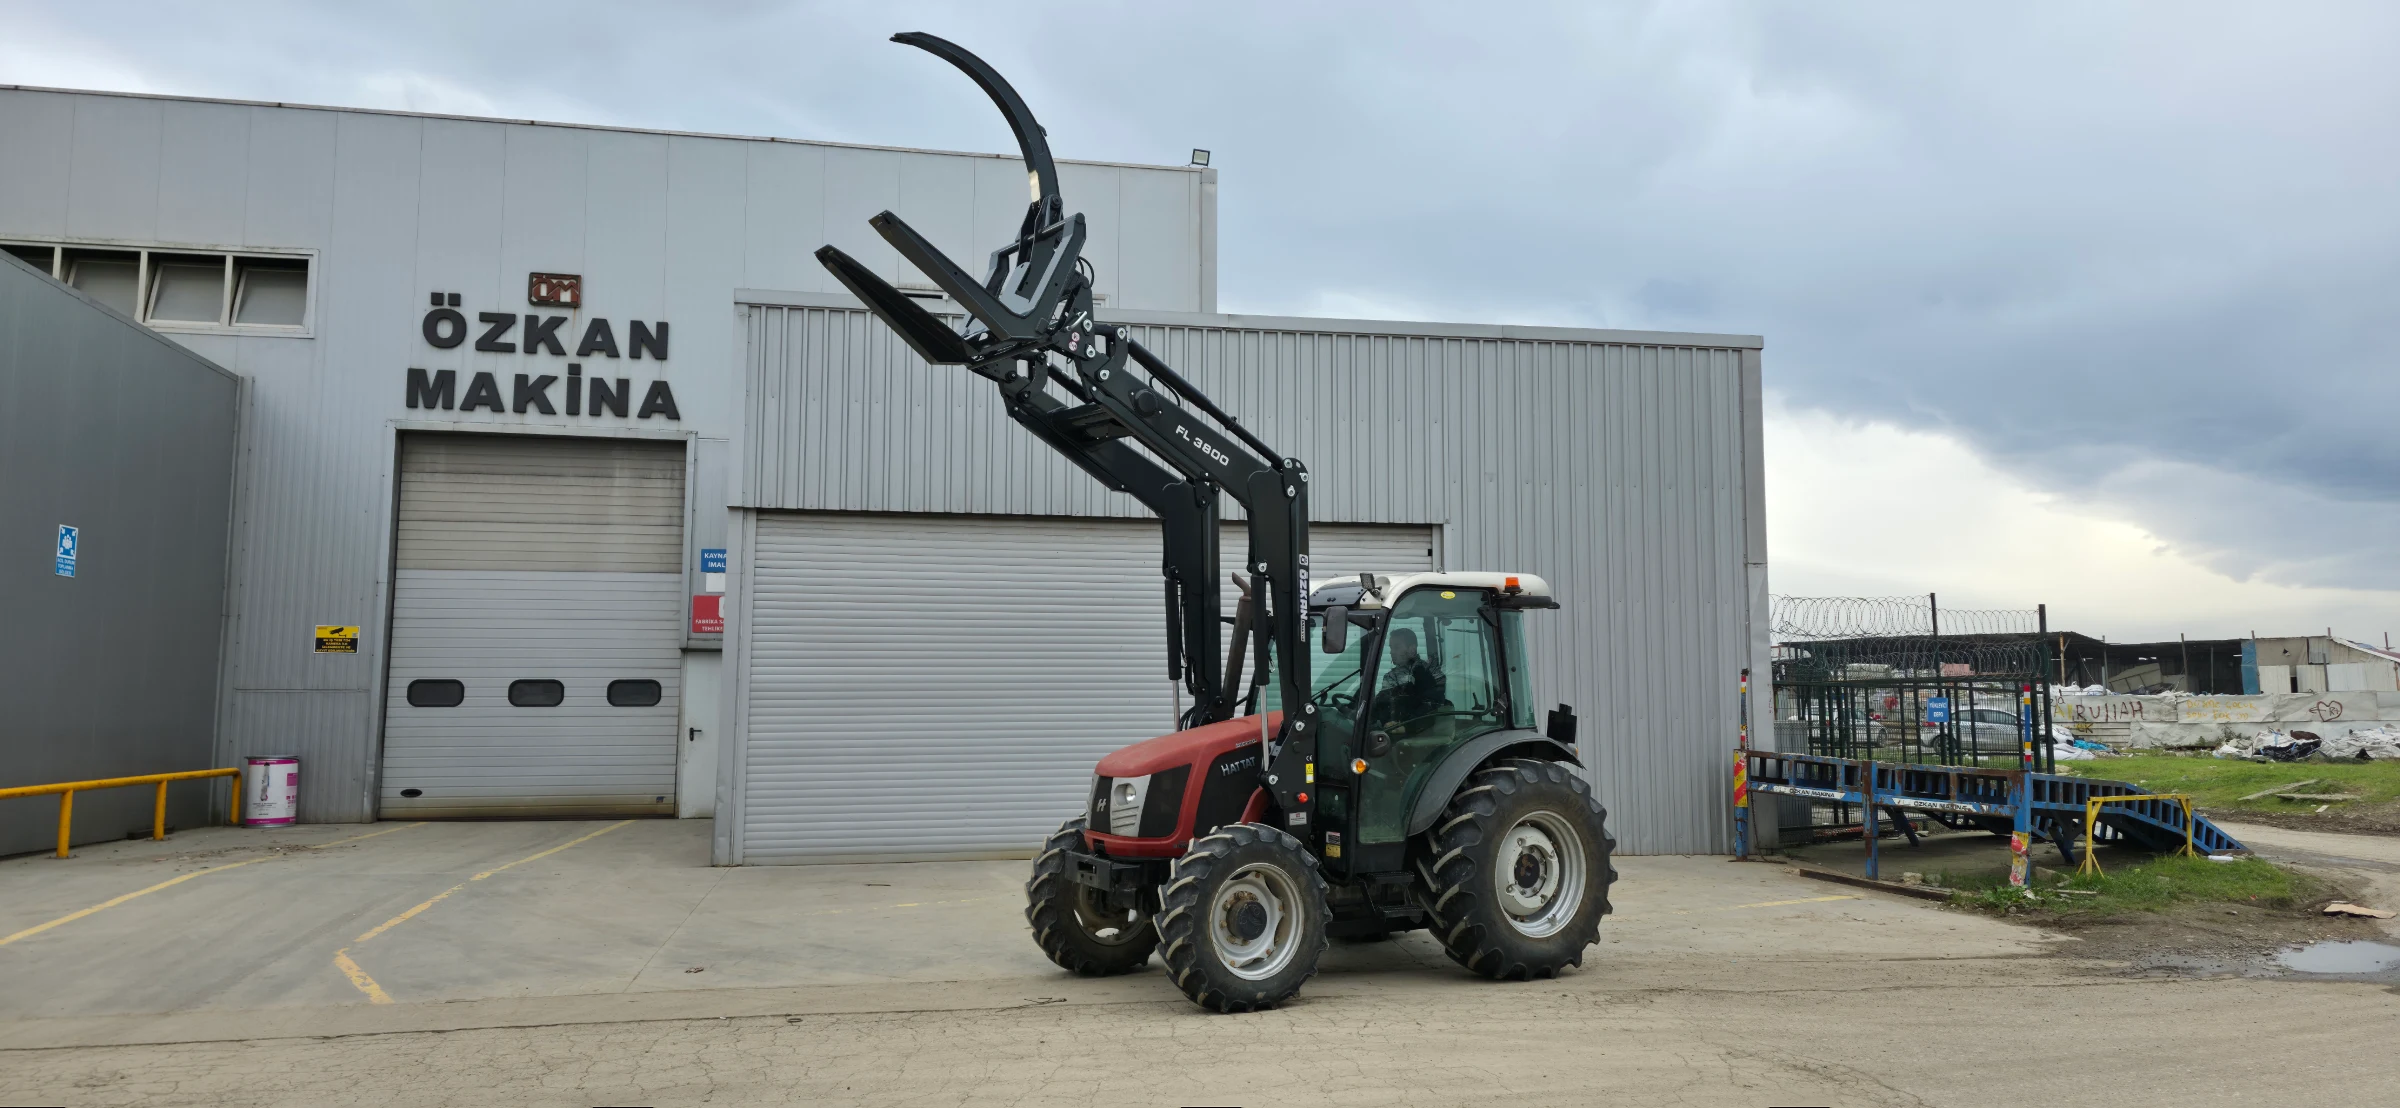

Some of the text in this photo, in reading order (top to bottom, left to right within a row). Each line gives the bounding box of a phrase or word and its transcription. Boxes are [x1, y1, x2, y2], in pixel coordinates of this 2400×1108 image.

[422, 292, 668, 360] ÖZKAN
[406, 363, 680, 421] MAKİNA
[1175, 425, 1229, 467] FL 3800
[1299, 569, 1309, 620] ÖZKAN
[1220, 756, 1255, 776] HATTAT
